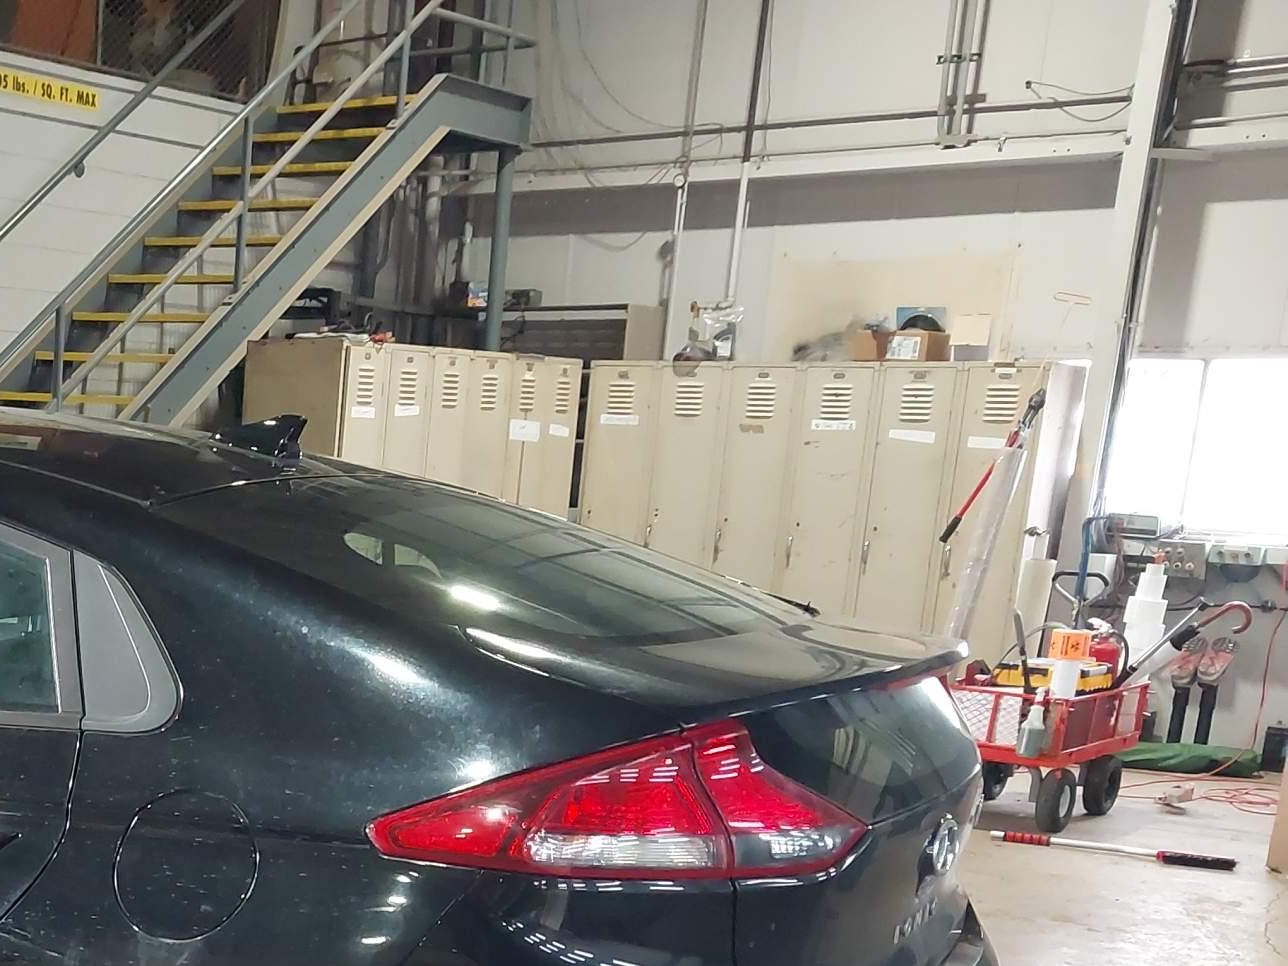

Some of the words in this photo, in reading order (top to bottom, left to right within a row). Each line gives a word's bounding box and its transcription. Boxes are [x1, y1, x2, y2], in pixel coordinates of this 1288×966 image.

[12, 75, 29, 94] lbs.
[33, 80, 38, 96] /
[41, 82, 56, 100] SQ.
[60, 86, 73, 102] FT.
[76, 90, 97, 107] MAX
